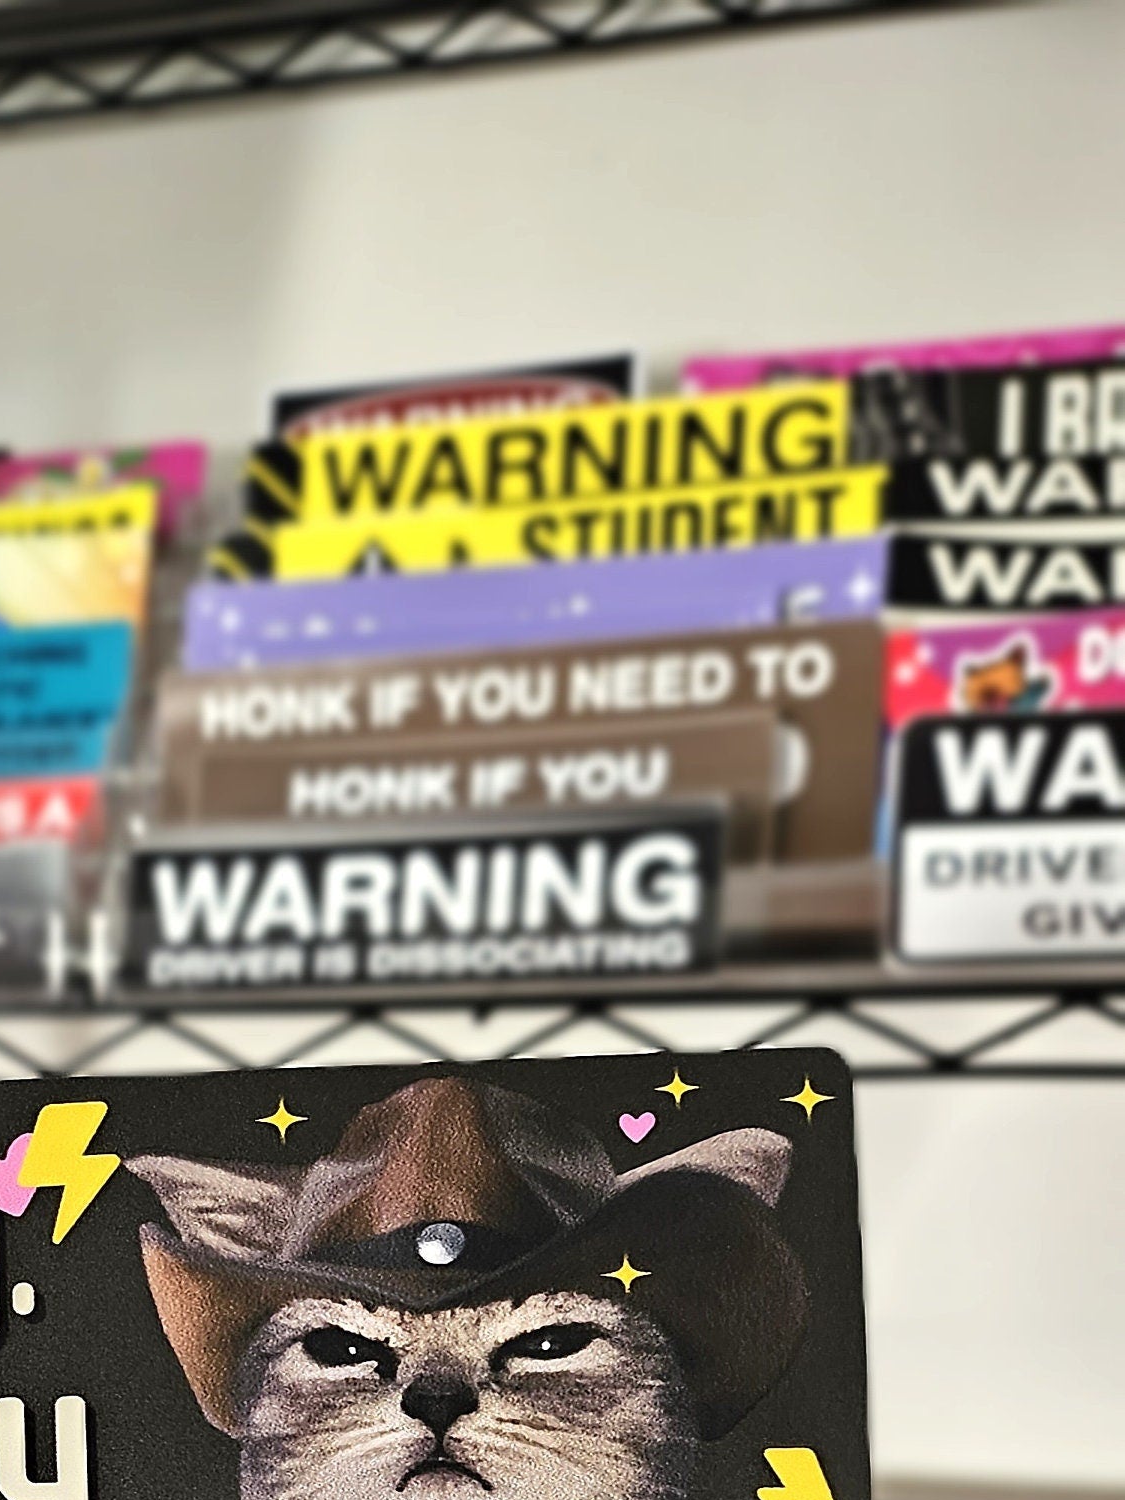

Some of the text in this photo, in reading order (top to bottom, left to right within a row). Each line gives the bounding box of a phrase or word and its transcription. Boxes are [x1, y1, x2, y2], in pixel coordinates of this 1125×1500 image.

[1000, 376, 1025, 457] I
[324, 397, 838, 520] WARNING
[926, 456, 1125, 517] WA
[926, 542, 1125, 606] WA
[200, 640, 837, 741] HONK IF YOU NEED TO
[288, 748, 669, 818] HONK IF YOU
[151, 833, 702, 947] WARNING
[147, 928, 691, 989] DRIVER IS DISSOCIATING
